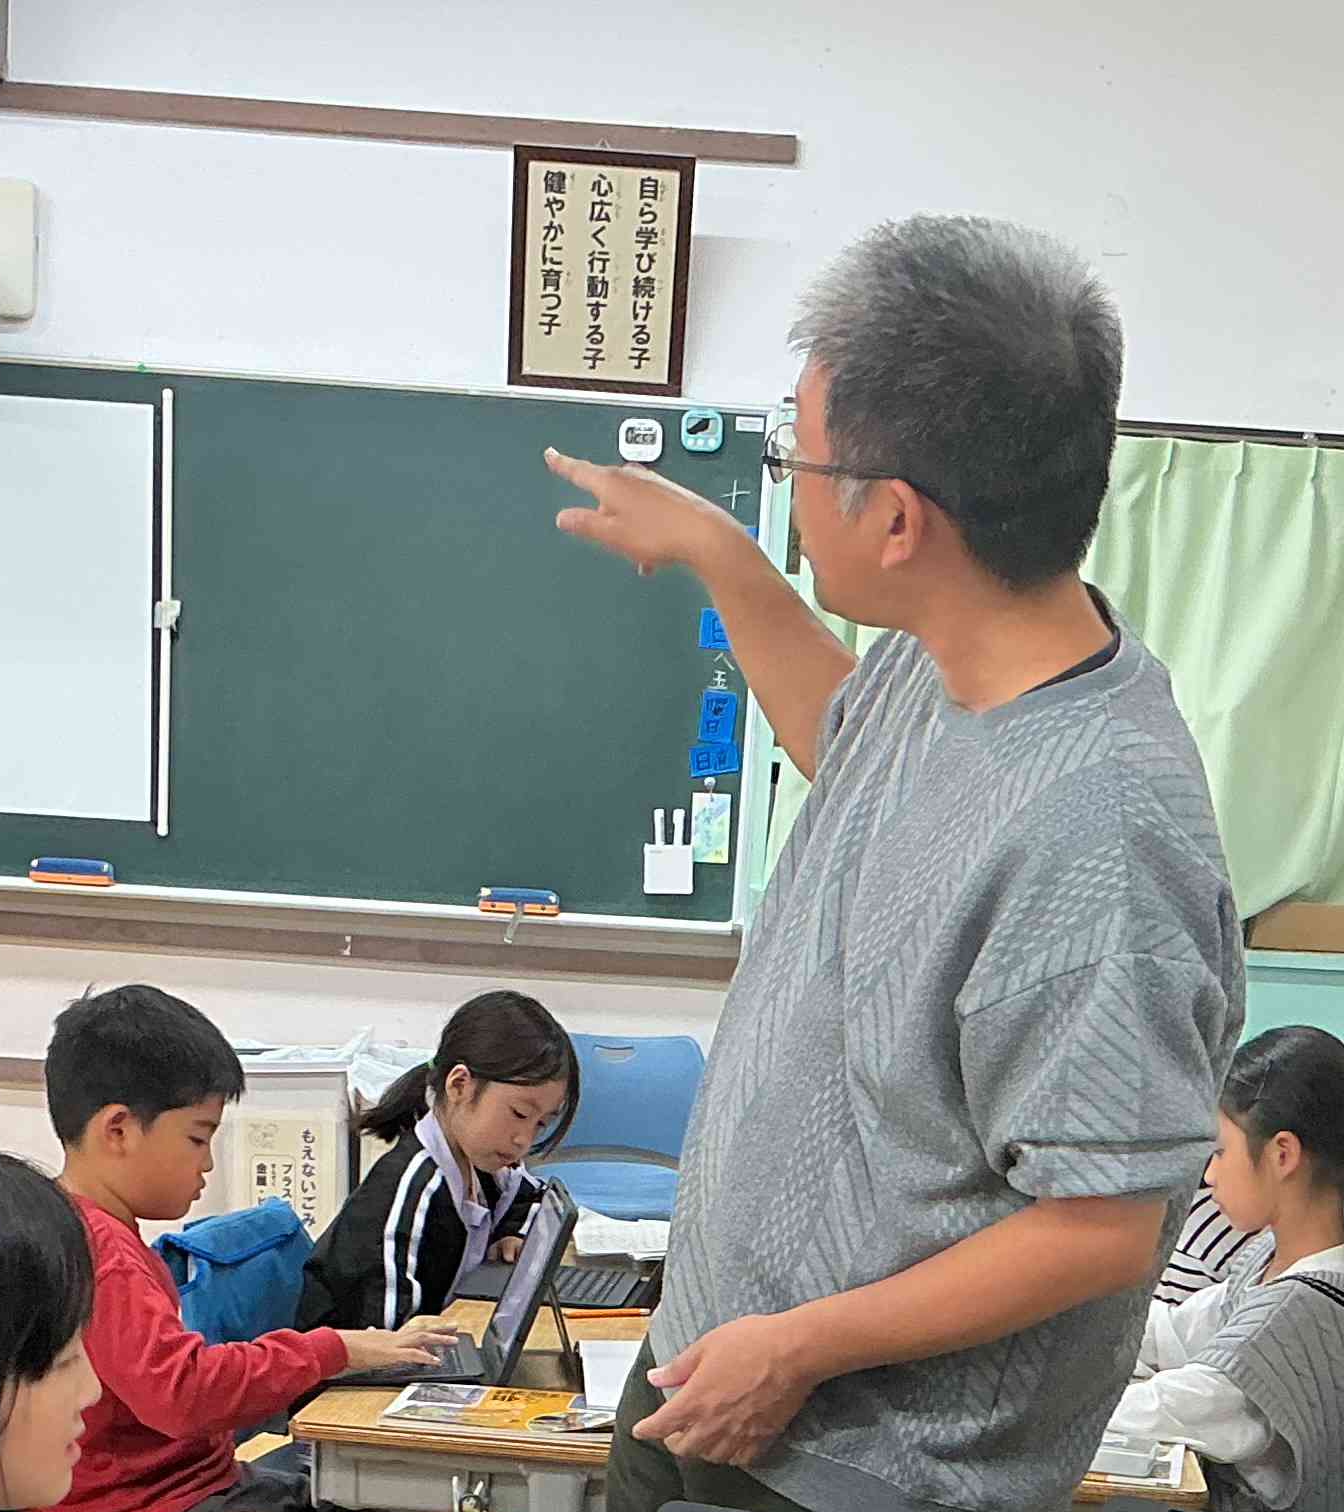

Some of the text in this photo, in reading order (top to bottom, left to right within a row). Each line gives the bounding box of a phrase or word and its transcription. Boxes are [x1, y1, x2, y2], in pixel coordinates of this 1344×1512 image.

[538, 170, 566, 336] 健やかに育つ子
[583, 174, 613, 370] 心広く行動する子
[629, 176, 658, 370] 自ら学び続ける子
